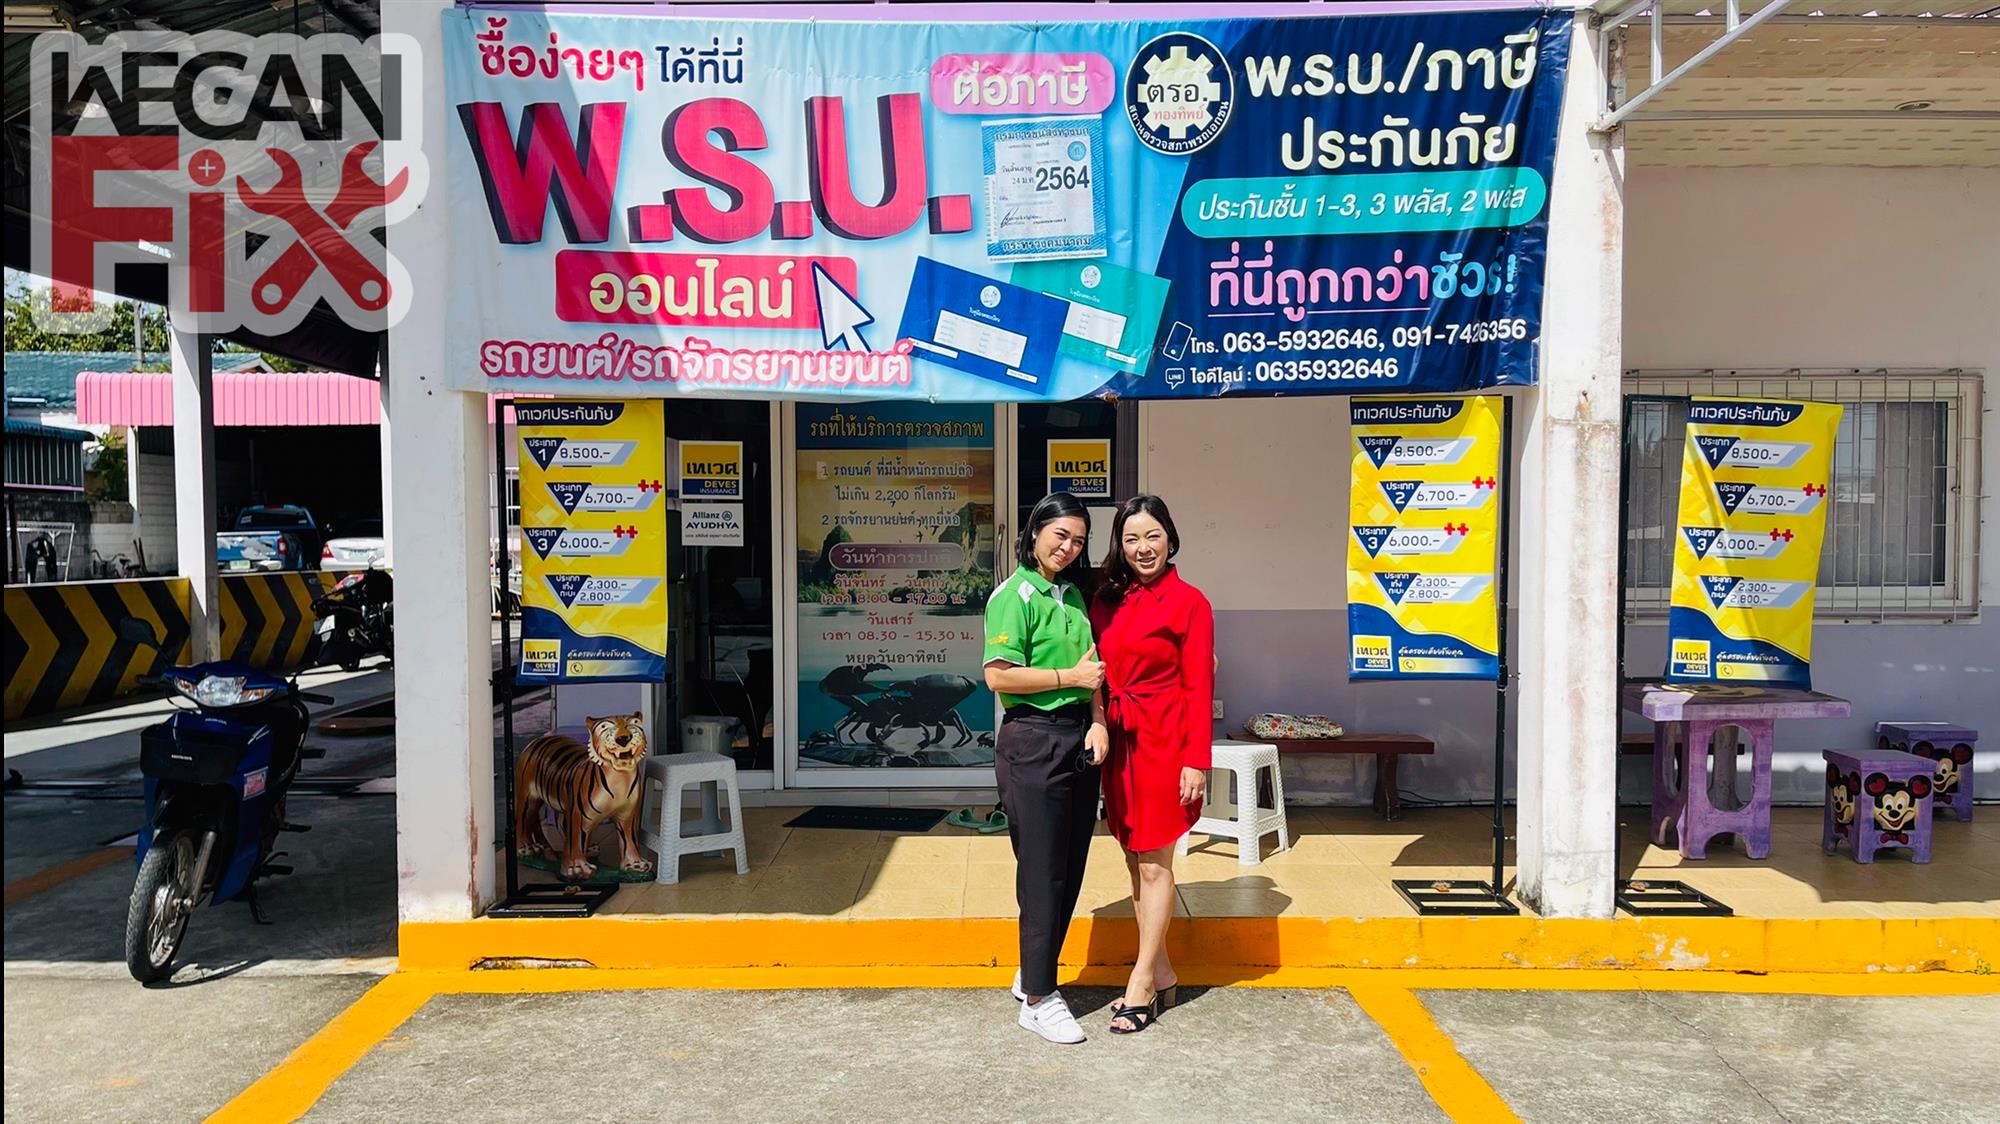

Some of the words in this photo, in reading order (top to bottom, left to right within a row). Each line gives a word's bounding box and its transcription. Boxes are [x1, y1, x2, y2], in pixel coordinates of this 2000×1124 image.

[476, 17, 645, 91] ซื้อง่ายๆ
[655, 36, 744, 84] ได้ที่นี่
[1243, 27, 1540, 98] พ.ร.บ./ภาษี
[952, 61, 1089, 109] ต่อภาษี
[1147, 83, 1208, 103] ตรอ.
[1153, 104, 1205, 121] ทองทิพย์
[1128, 100, 1230, 152] สถานตรวจสภาพรถเอกชน
[1281, 111, 1516, 171] ประกันภัย
[1035, 165, 1090, 191] 2564
[1199, 182, 1308, 221] ประกันชั้น
[1314, 194, 1362, 219] 1-3,
[1369, 194, 1387, 216] 3
[1392, 187, 1453, 216] พลัส,
[1460, 190, 1477, 212] 2
[1485, 185, 1529, 209] พลัส
[589, 258, 795, 318] ออนไลน์
[1190, 337, 1219, 354] โทร.
[1223, 327, 1385, 353] 063-5932646,
[1392, 319, 1527, 347] 091-7426356
[480, 332, 914, 385] รถยนต์/รถจักรยานยนต์
[1190, 365, 1244, 384] ไอดีไลน์
[1255, 357, 1398, 382] 0635932646
[517, 405, 614, 421] เทเวศประกันภัย
[1353, 404, 1452, 420] เทเวศประกันภัย
[1691, 406, 1790, 422] เทเวศประกันภัย
[810, 408, 984, 437] รถที่ให้บริการตรวจสภาพ
[538, 449, 546, 461] 1
[1373, 448, 1381, 460] 1
[1709, 448, 1717, 460] 1
[687, 462, 739, 475] เทเวศ
[834, 461, 871, 476] รถยนต์
[876, 456, 974, 477] ที่มีน้ำหนักรถเปล่า
[1055, 460, 1107, 473] เทเวศ
[704, 480, 737, 488] DEVES
[1072, 478, 1105, 486] DEVES
[563, 493, 574, 505] 2
[835, 485, 869, 501] ไม่เกิน
[875, 490, 909, 502] 2,200
[914, 487, 956, 501] กิโลกรัม
[1395, 492, 1405, 504] 2
[1725, 494, 1735, 506] 2
[692, 511, 720, 519] Allianz
[822, 515, 829, 525] 2
[537, 538, 548, 551] 3
[1367, 537, 1378, 549] 3
[1697, 538, 1706, 550] 3
[833, 574, 886, 588] วันจันทร์
[821, 593, 852, 604] เวลา
[857, 593, 888, 604] 8.00
[906, 593, 947, 605] 17.00
[951, 595, 966, 605] น.
[867, 612, 914, 625] วันเสาร์
[822, 631, 851, 641] เวลา
[858, 631, 896, 641] 08.30
[916, 631, 955, 641] 15.30
[961, 632, 974, 641] น.
[845, 648, 948, 667] หยุดวันอาทิตย์
